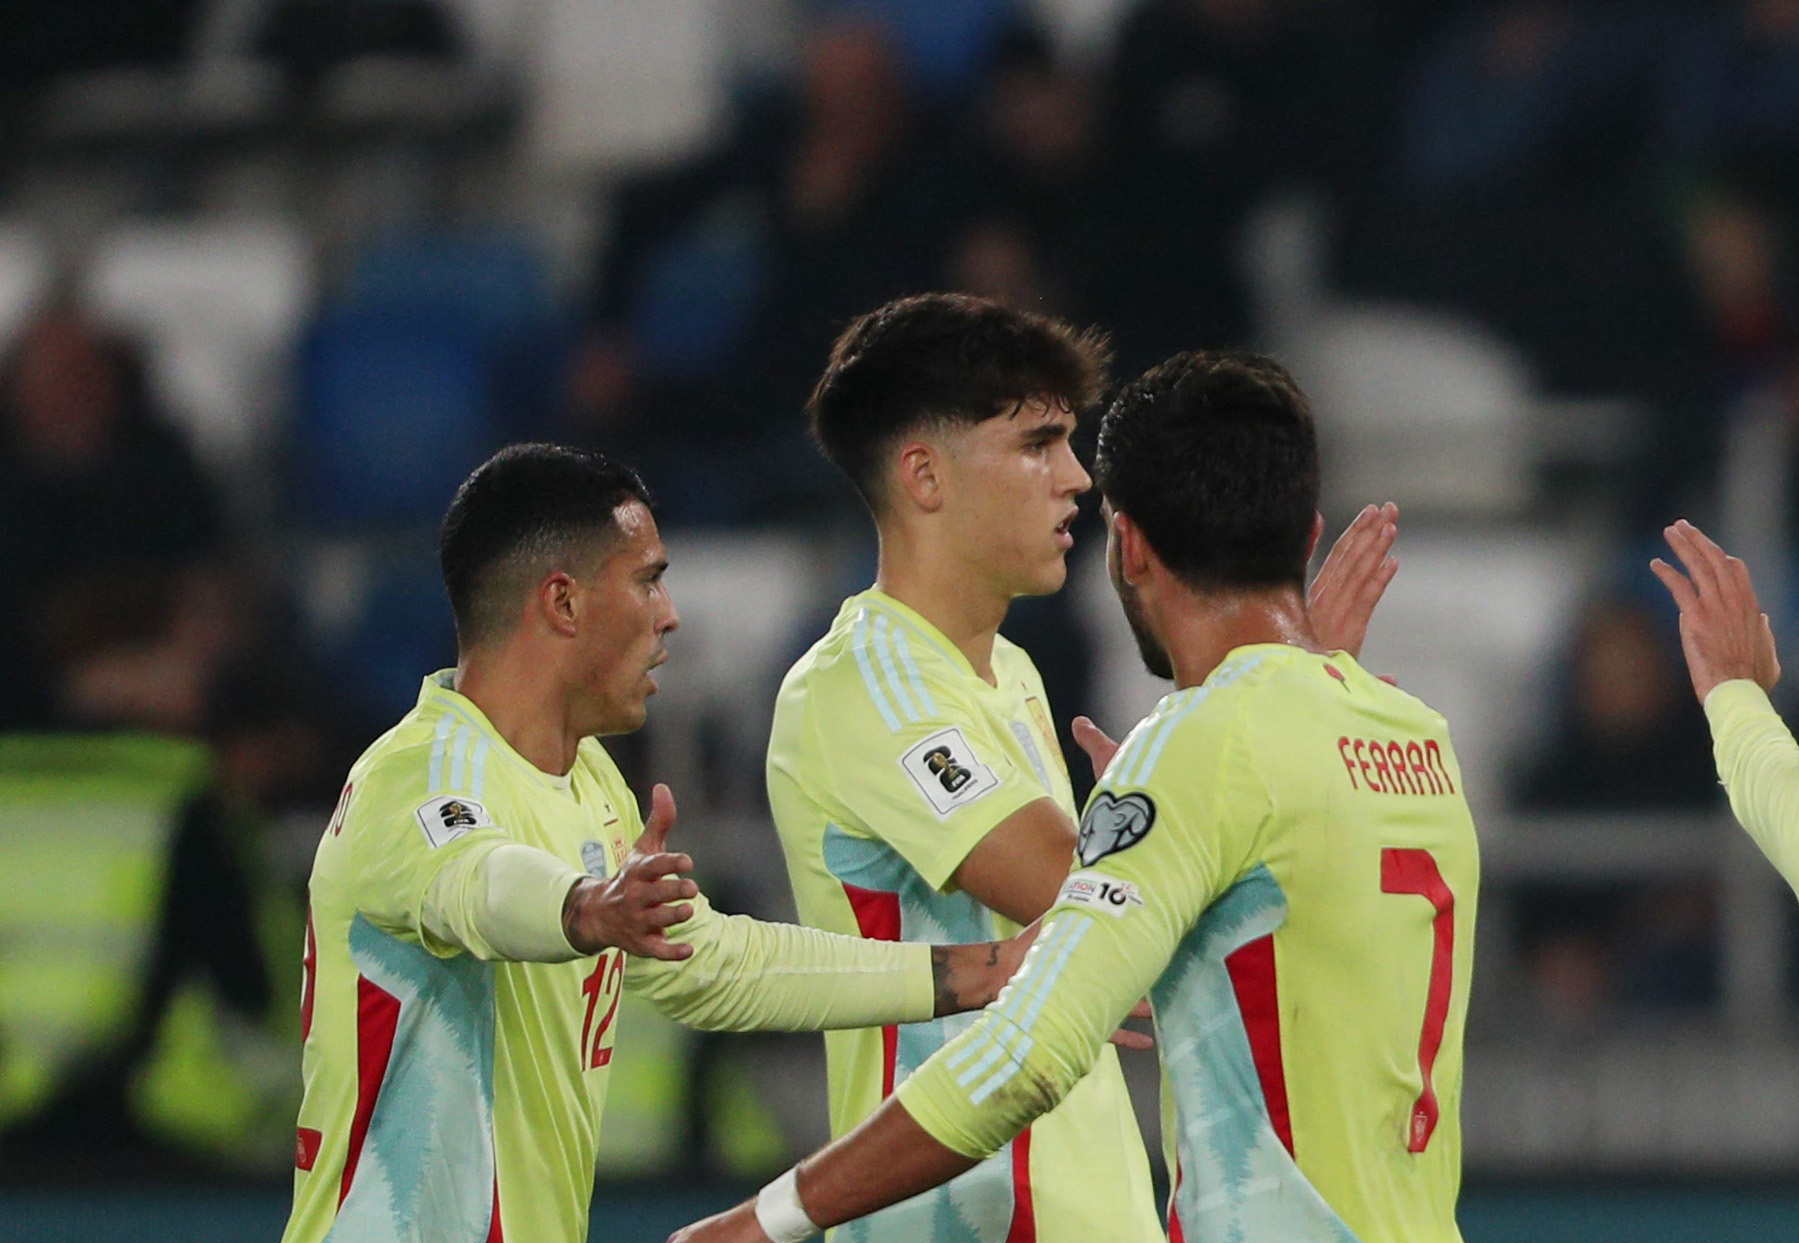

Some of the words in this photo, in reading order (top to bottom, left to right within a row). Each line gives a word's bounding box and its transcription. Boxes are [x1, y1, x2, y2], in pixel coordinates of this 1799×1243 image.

[1338, 736, 1456, 795] FERRAN
[581, 948, 624, 1073] 12
[1381, 848, 1455, 1153] 7
